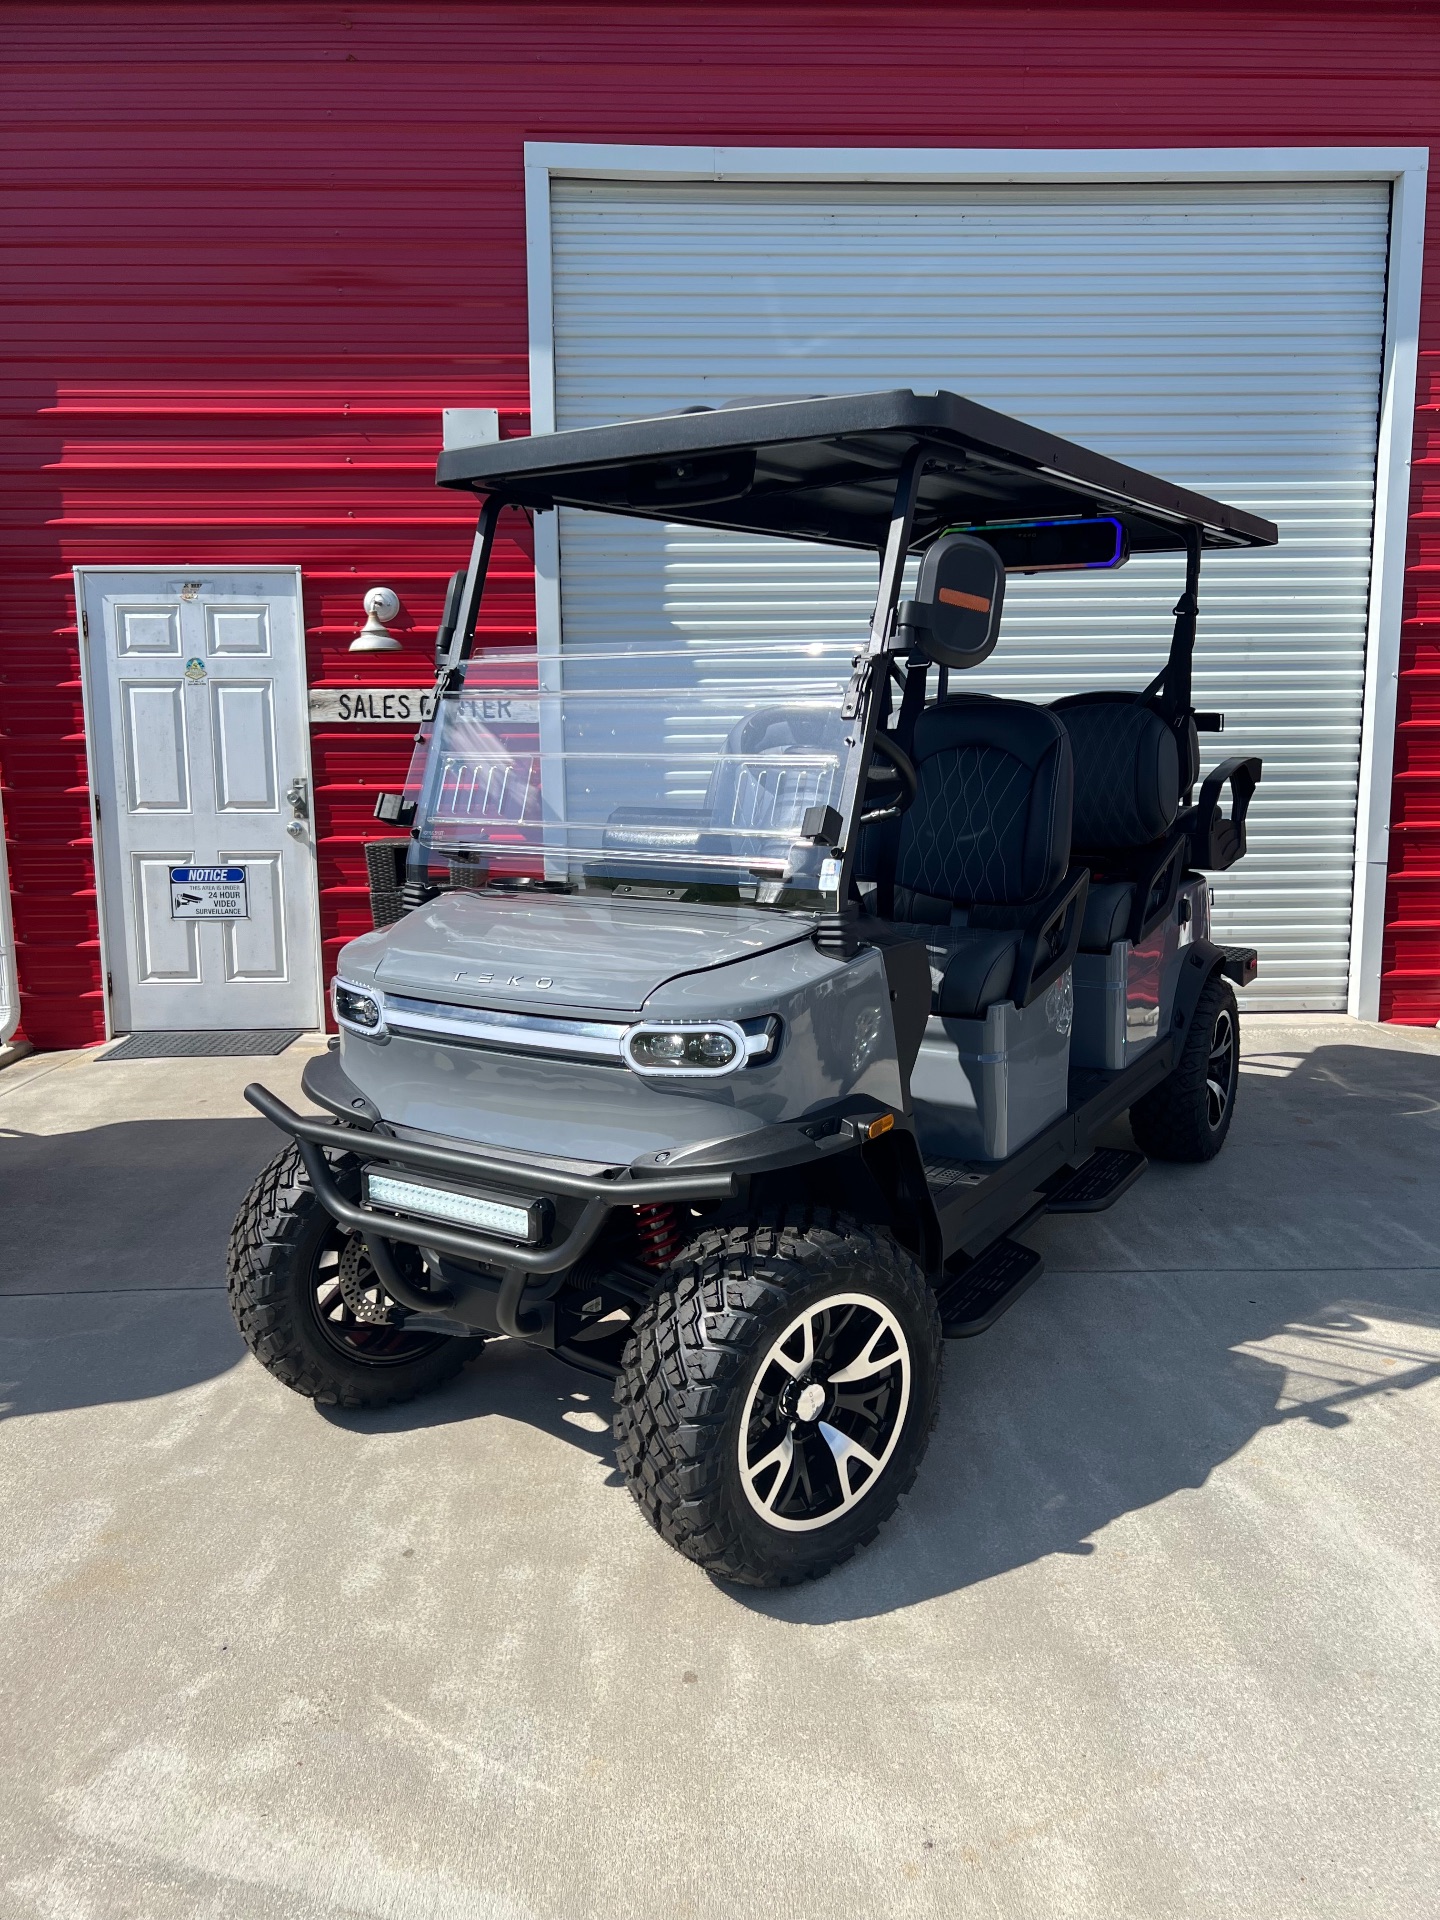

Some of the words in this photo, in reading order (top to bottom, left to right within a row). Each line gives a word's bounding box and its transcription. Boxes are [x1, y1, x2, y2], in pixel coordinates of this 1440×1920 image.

[338, 694, 411, 720] SALES
[188, 869, 228, 881] NOTICE
[208, 891, 218, 899] 24
[220, 891, 241, 899] HOUR
[213, 900, 236, 908] VIDEO
[452, 971, 554, 989] TEKO
